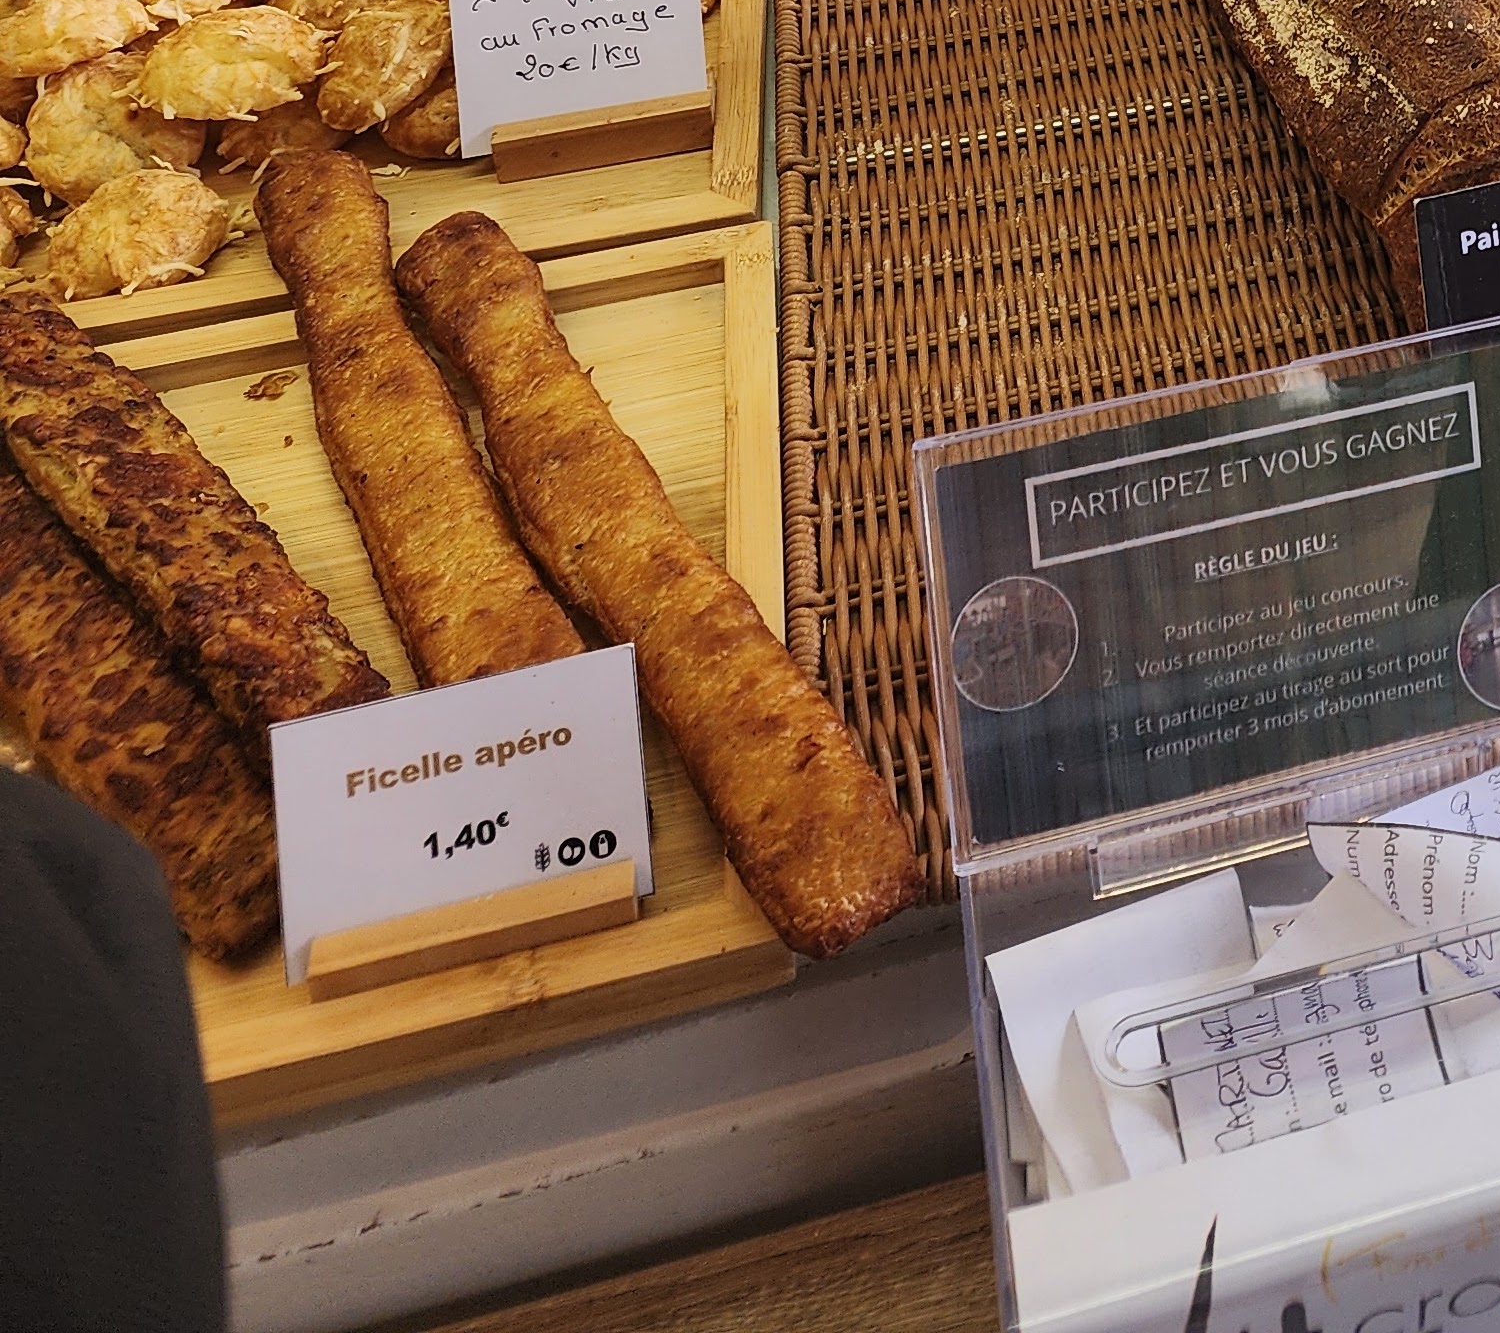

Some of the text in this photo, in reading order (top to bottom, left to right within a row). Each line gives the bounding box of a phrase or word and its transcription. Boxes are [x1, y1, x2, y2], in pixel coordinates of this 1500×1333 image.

[480, 33, 521, 52] au
[1050, 411, 1460, 526] PARTICIPEZ ET VOUS GAGNEZ
[1194, 532, 1328, 581] RÈGLE DU JEU
[1135, 658, 1184, 679] Vous
[1187, 631, 1284, 667] remportez
[1290, 601, 1400, 641] directement
[1405, 593, 1440, 614] une
[1164, 608, 1254, 643] Participez
[1259, 602, 1283, 621] au
[1288, 595, 1316, 619] jeu
[1321, 574, 1409, 605] concours.
[1134, 714, 1152, 736] Et
[1158, 694, 1249, 734] participez
[1254, 687, 1277, 707] au
[1282, 672, 1335, 699] tirage
[1339, 666, 1363, 685] au
[1367, 656, 1402, 680] sort
[1407, 645, 1450, 674] pour
[1203, 636, 1379, 690] séance découverte.
[1145, 672, 1445, 762] remporter 3 mois d'abonnement
[345, 726, 574, 799] Ficelle apéro
[1421, 834, 1445, 916] Prénom
[1465, 837, 1488, 884] Nom
